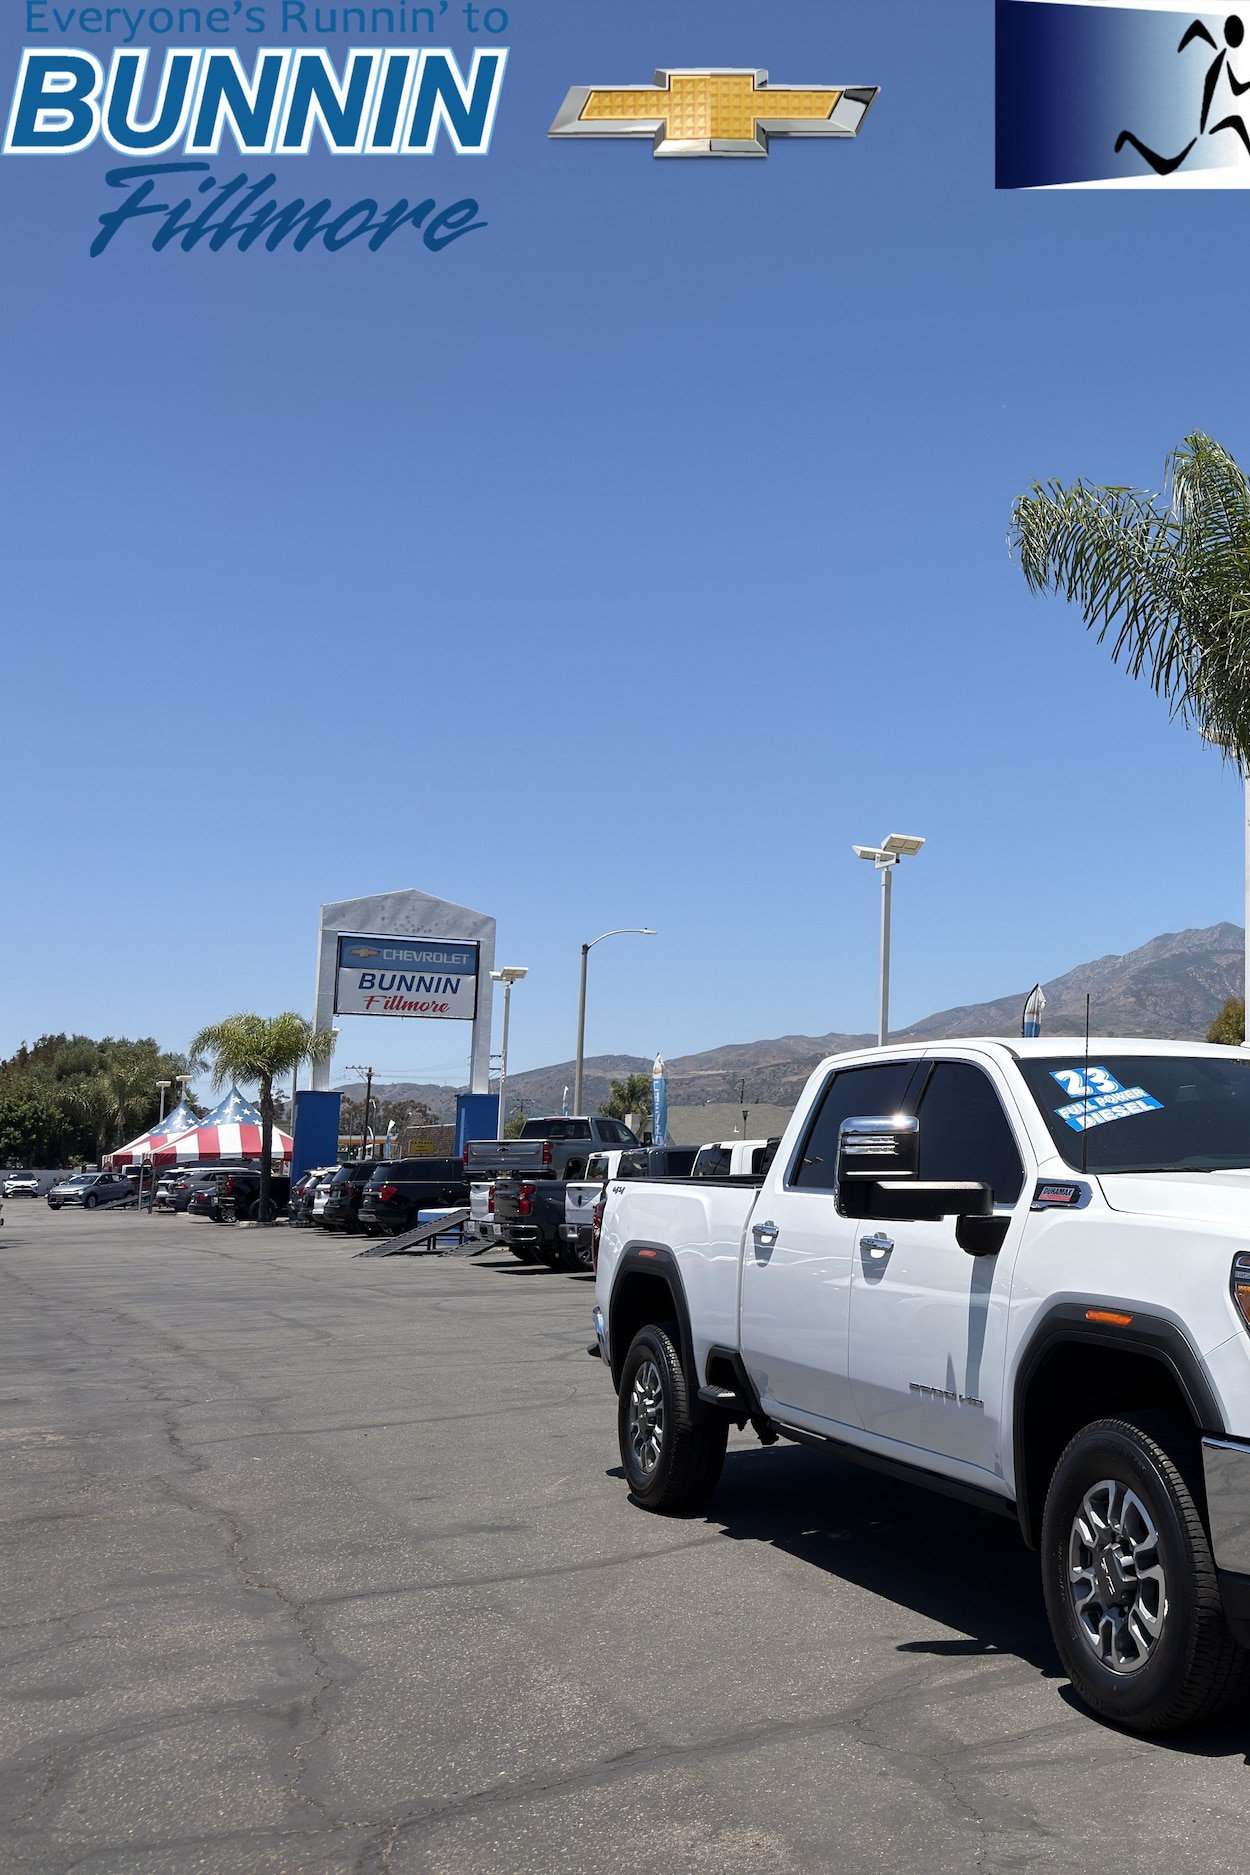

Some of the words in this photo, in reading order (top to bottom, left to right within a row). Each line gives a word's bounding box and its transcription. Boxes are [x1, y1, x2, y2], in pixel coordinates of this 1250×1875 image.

[382, 949, 470, 965] CHEVROLET
[358, 972, 461, 995] BUNNIN
[363, 995, 451, 1014] Fillmore
[1054, 1067, 1119, 1096] 23
[1094, 1088, 1146, 1107] POWER
[1075, 1100, 1156, 1129] DIESEL
[1043, 1187, 1074, 1196] DURAMAX
